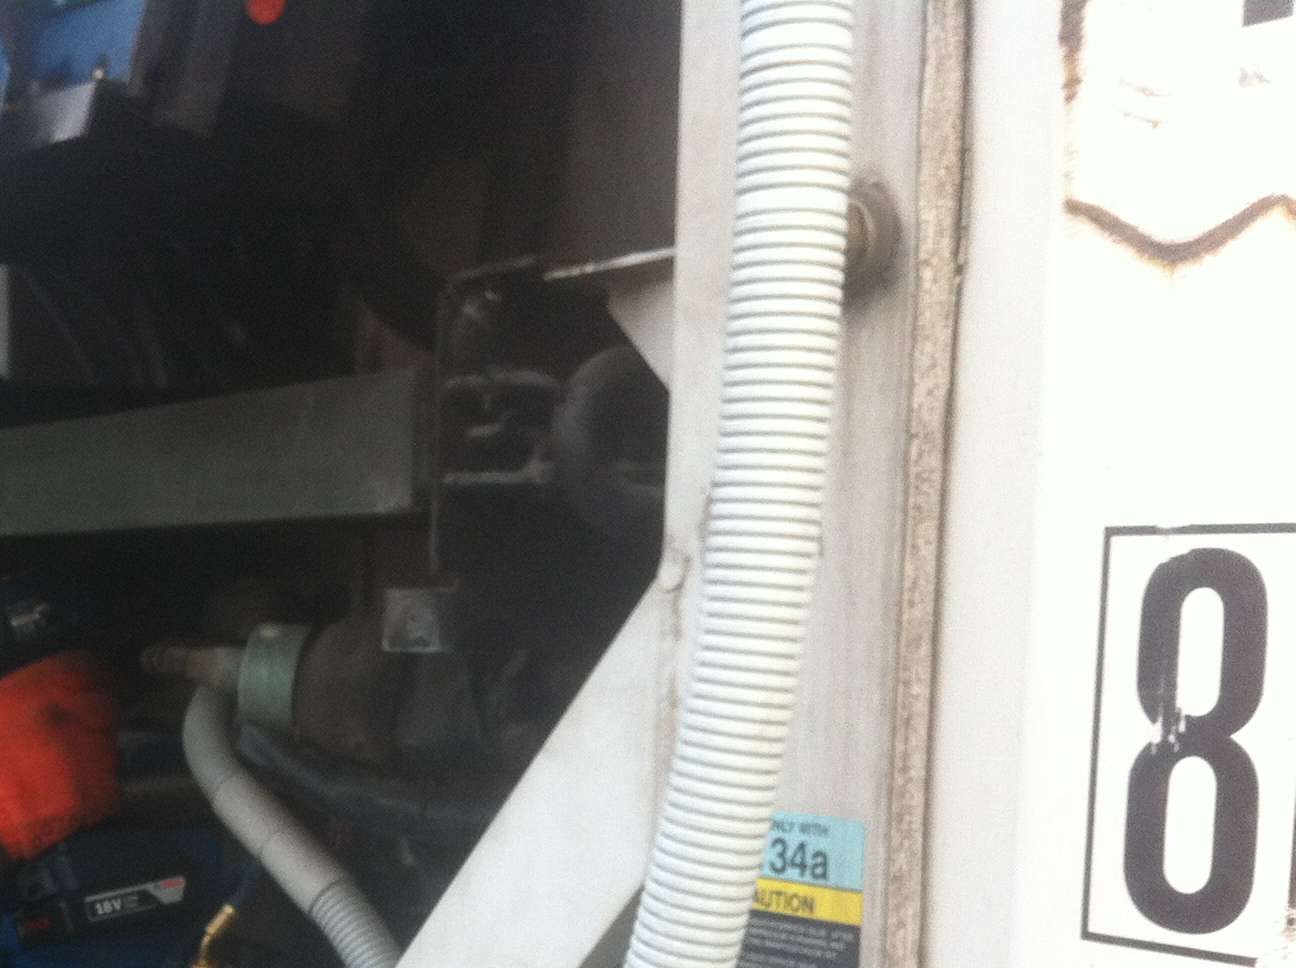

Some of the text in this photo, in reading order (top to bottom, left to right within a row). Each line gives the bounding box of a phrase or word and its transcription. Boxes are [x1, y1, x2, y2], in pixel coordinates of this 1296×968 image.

[1123, 547, 1269, 935] 8
[768, 837, 829, 881] 34a
[94, 898, 122, 915] 18V
